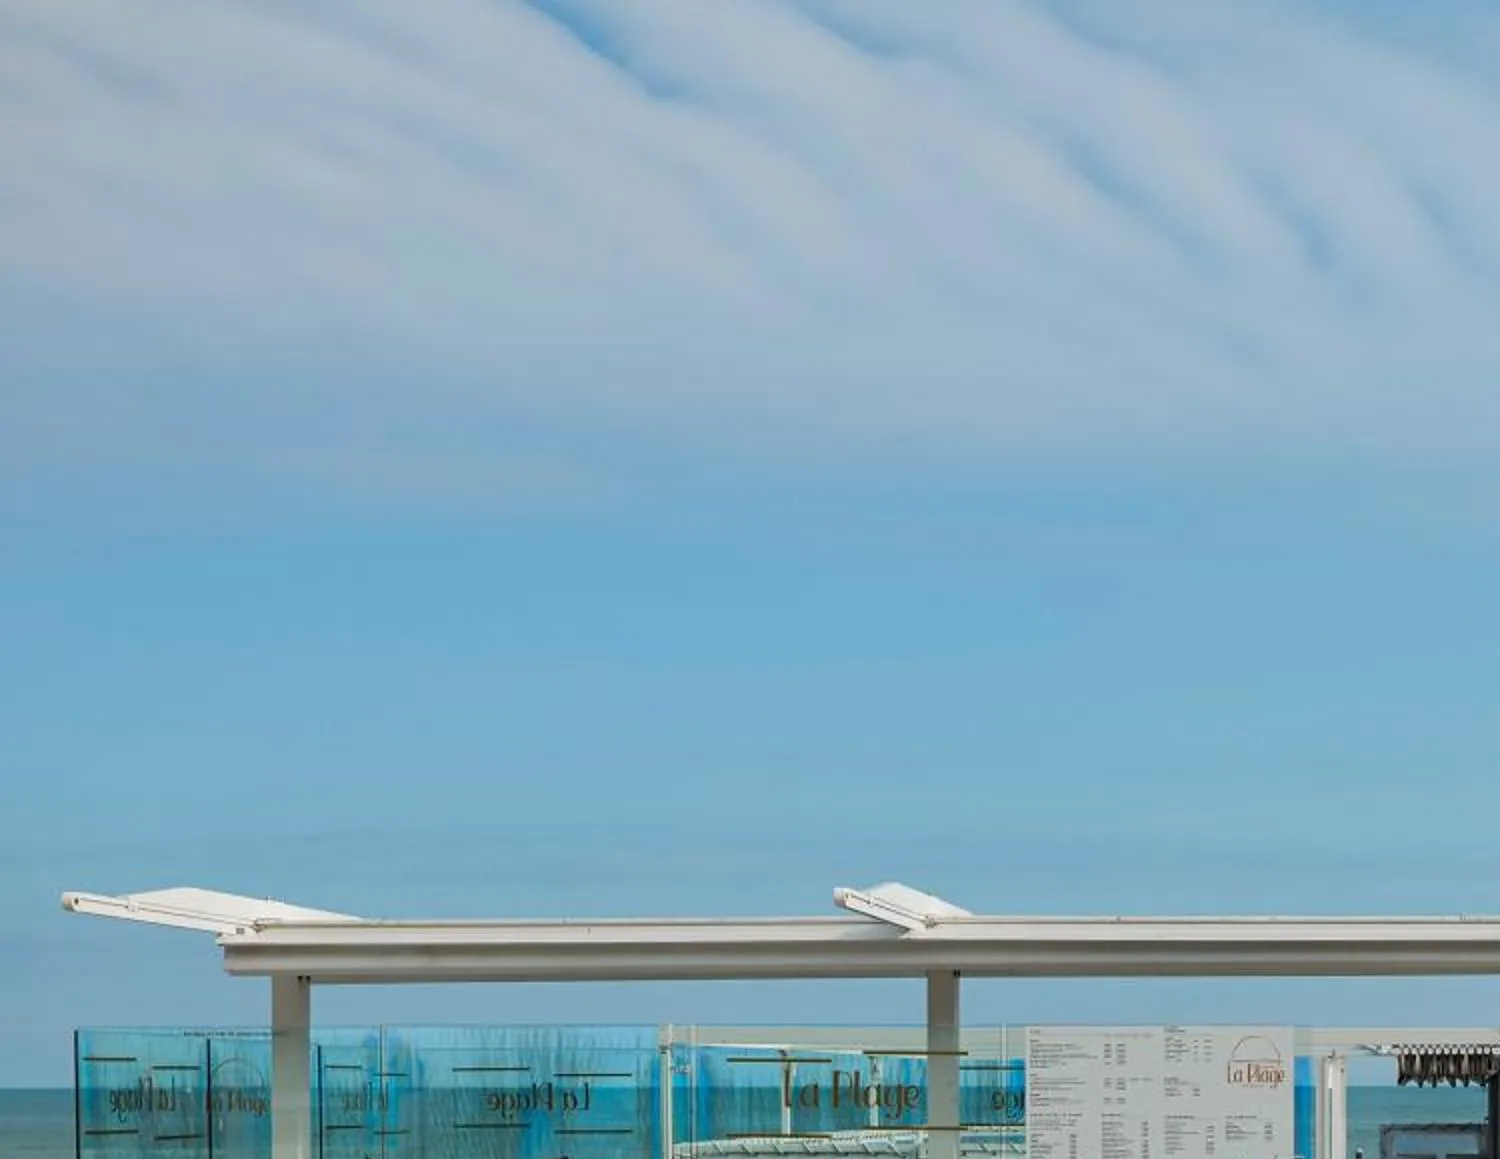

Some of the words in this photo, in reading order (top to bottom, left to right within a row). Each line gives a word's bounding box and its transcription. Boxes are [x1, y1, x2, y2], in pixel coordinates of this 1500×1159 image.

[1227, 1060, 1243, 1084] La
[784, 1069, 820, 1108] La
[832, 1070, 919, 1119] Plage
